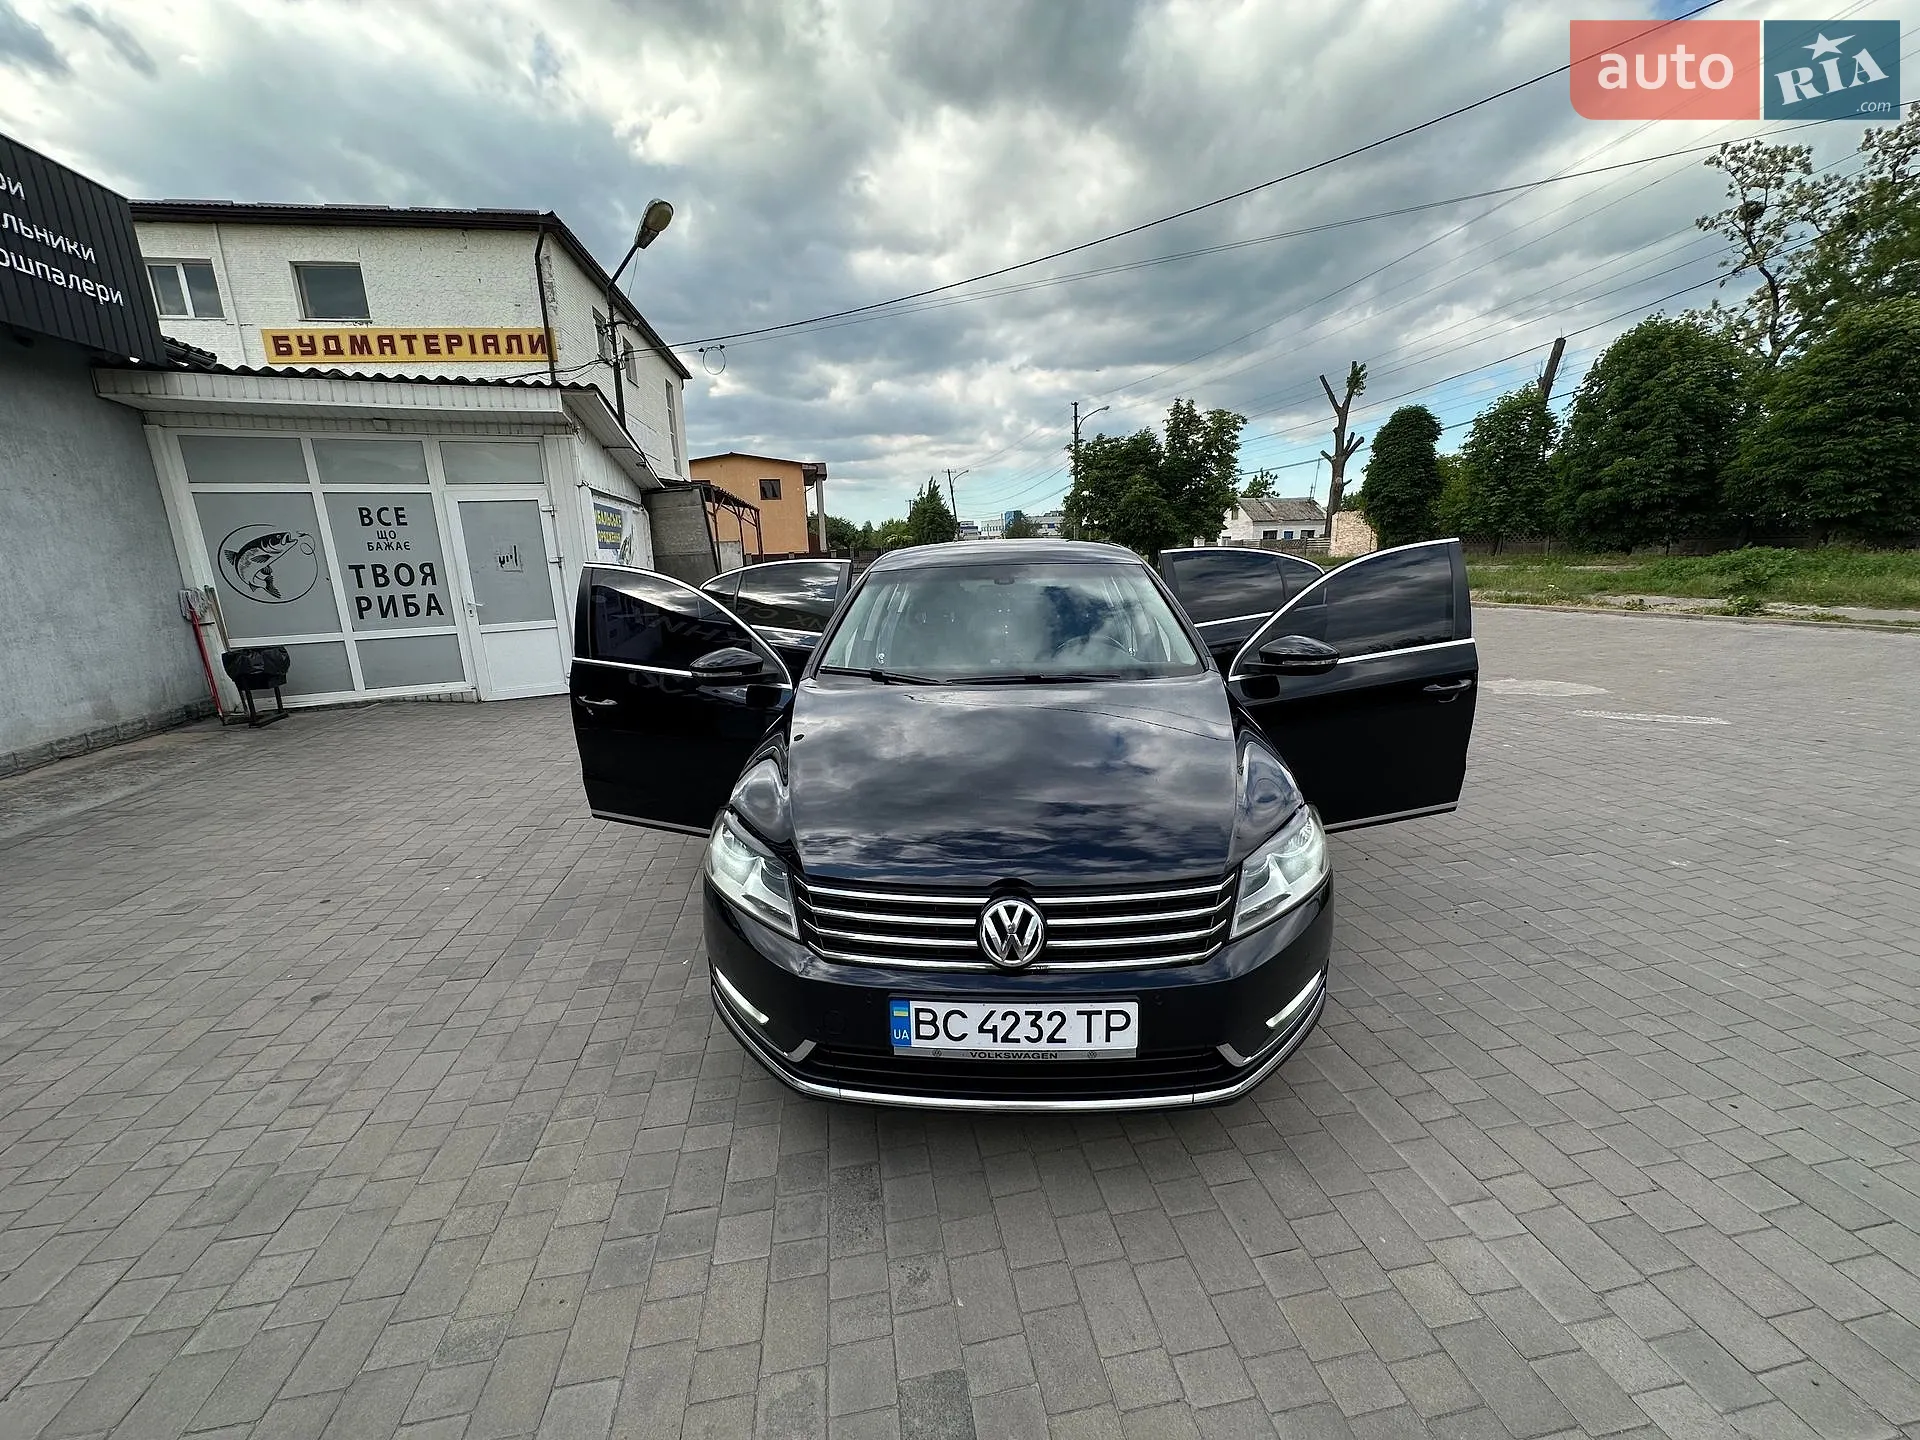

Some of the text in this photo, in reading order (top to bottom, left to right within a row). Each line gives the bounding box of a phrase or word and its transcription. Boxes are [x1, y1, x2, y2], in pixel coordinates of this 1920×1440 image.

[271, 334, 548, 356] БУДМАТЕРІАЛИ
[358, 506, 408, 527] ВСЕ
[376, 530, 397, 541] ЩО
[366, 541, 411, 552] БАЖАЄ
[348, 562, 437, 589] ТВОЯ
[355, 593, 444, 620] РИБА
[893, 1029, 910, 1040] UA
[914, 1007, 1132, 1044] BC 4232 TP
[969, 1051, 1058, 1060] VOLKSWAGEN
